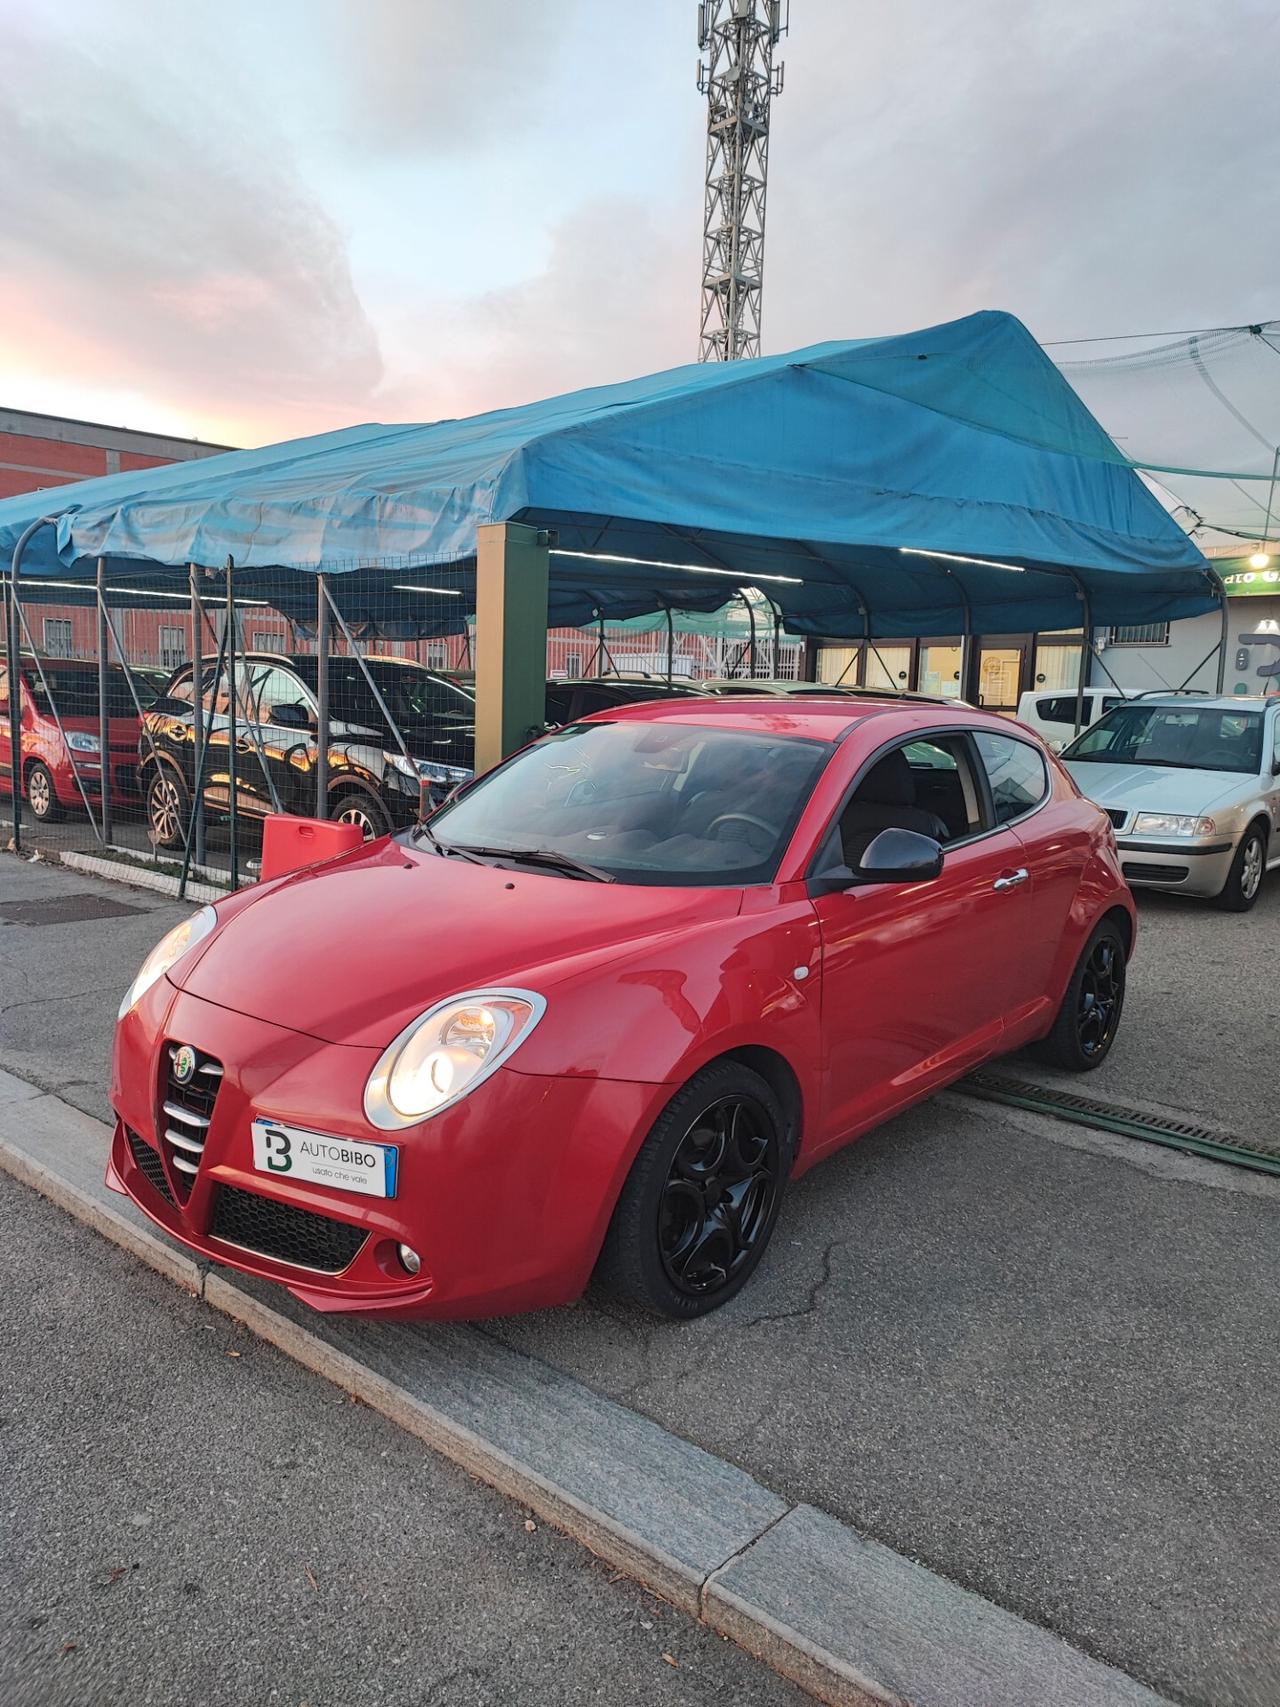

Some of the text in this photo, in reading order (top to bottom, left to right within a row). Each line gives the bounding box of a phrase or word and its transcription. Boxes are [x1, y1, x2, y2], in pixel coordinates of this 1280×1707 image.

[1223, 572, 1256, 585] ato
[300, 1141, 376, 1168] AUTOBIBO
[312, 1167, 368, 1185] usato che vale
